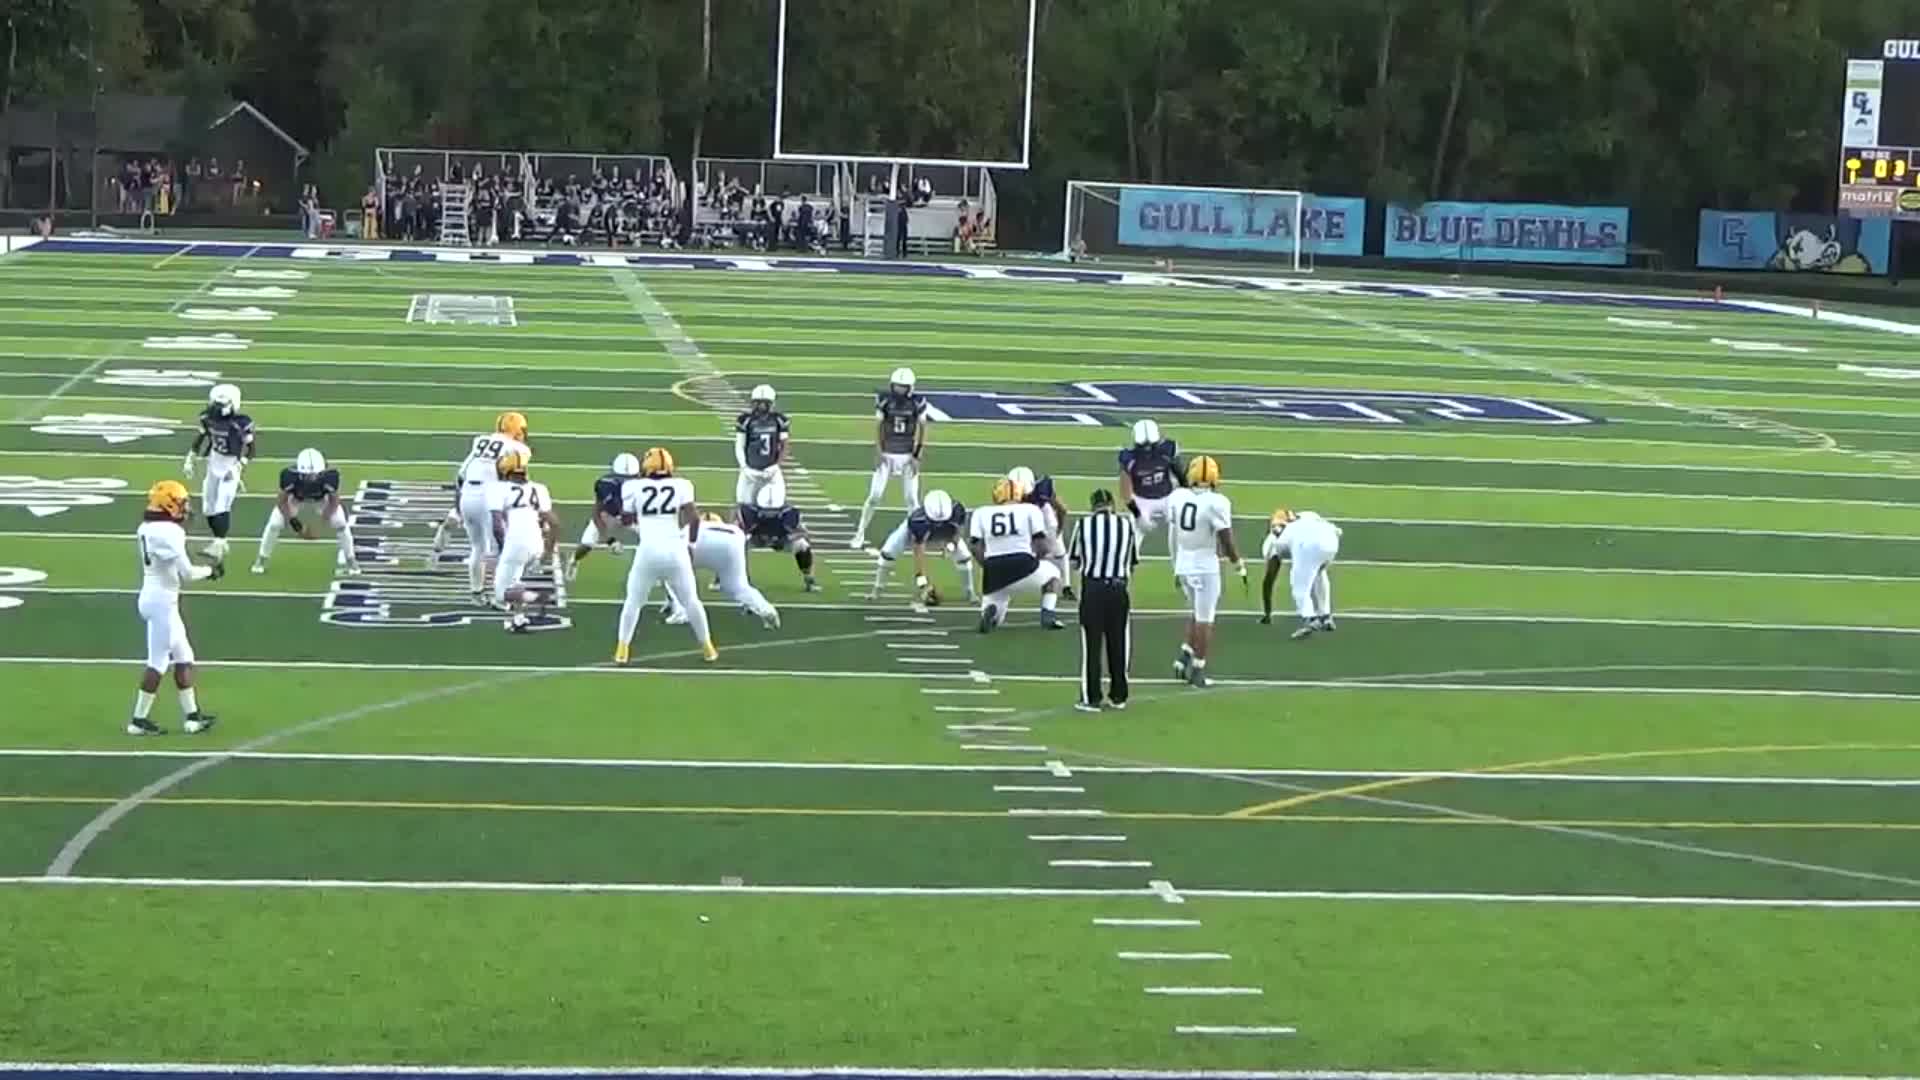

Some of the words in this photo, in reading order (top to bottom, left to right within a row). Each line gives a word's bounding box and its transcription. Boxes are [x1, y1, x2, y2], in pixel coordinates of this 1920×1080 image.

[1139, 201, 1233, 234] GULL
[1245, 206, 1347, 240] LAKE
[1395, 215, 1483, 244] BLUE
[1495, 217, 1618, 249] DEVILS
[893, 416, 905, 433] 5
[474, 439, 505, 460] 99
[759, 434, 771, 455] 3
[511, 486, 540, 511] 24
[641, 486, 676, 515] 22
[991, 511, 1020, 536] 61
[1180, 502, 1198, 531] 0
[141, 534, 151, 566] 1
